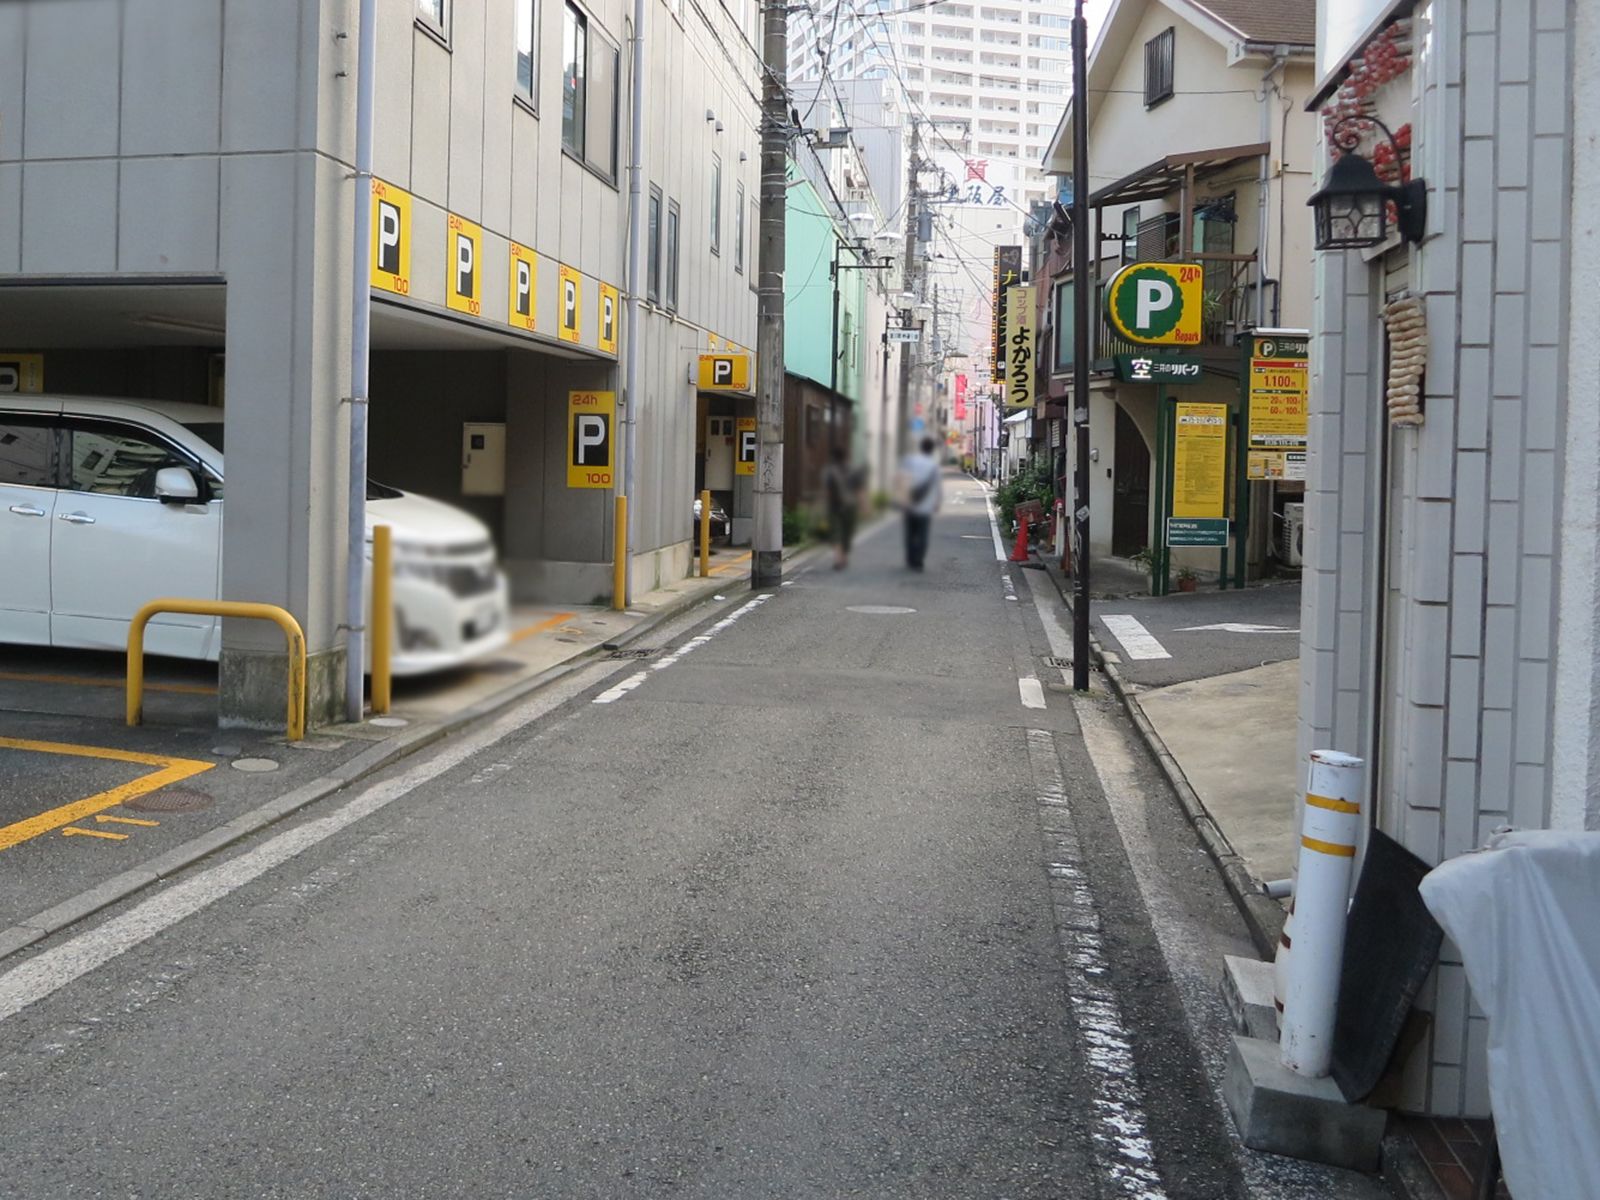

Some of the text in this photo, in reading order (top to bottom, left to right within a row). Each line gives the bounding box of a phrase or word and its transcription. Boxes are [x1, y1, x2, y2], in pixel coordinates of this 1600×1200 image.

[964, 159, 989, 183] 質
[379, 201, 399, 268] P
[449, 215, 464, 233] 24h
[457, 234, 473, 293] P
[393, 276, 409, 294] 100
[517, 260, 529, 311] P
[1180, 267, 1200, 283] 24h
[467, 299, 480, 315] 100
[565, 280, 575, 326] P
[1136, 279, 1173, 329] P
[604, 296, 612, 338] P
[1175, 328, 1199, 342] Repark
[1263, 343, 1273, 356] P
[715, 361, 731, 383] P
[1012, 326, 1031, 403] よかろう
[1131, 357, 1153, 379] 空
[1153, 363, 1199, 375] 三井のリパーク
[572, 394, 598, 406] 24h
[578, 415, 605, 464] P
[586, 473, 611, 484] 100
